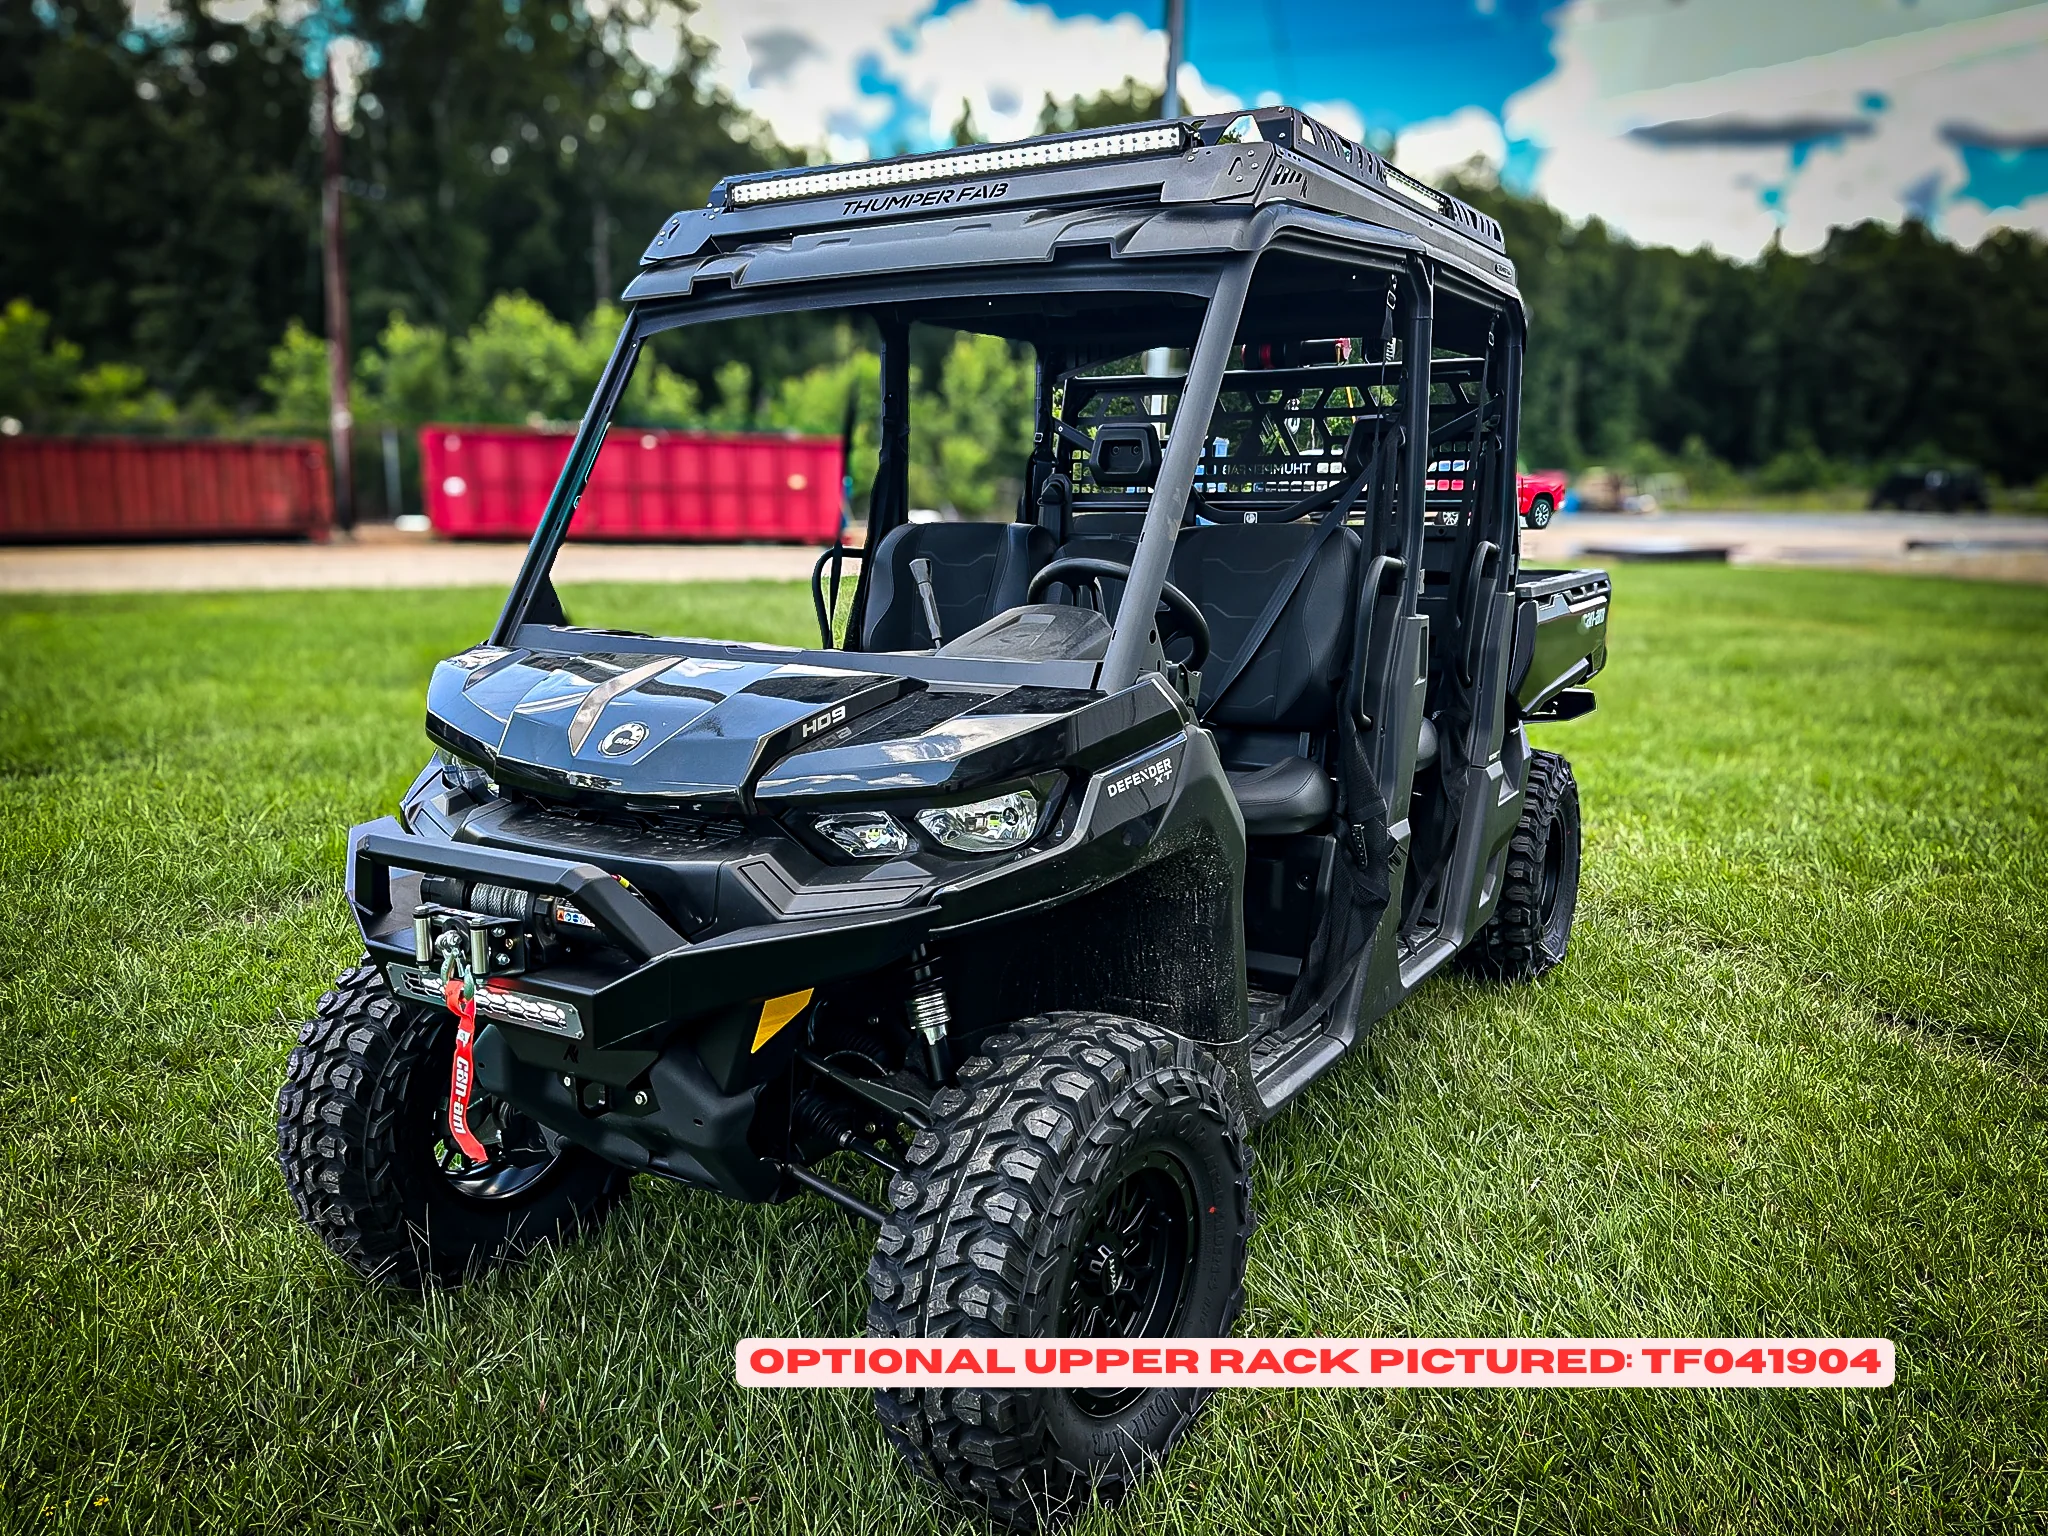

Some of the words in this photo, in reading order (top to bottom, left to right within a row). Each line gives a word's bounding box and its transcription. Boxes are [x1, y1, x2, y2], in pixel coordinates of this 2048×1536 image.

[842, 189, 955, 216] THUMPER
[955, 183, 1009, 203] FAB
[802, 705, 846, 738] HD9
[1106, 758, 1173, 798] DEFENDER
[1153, 769, 1173, 787] XT
